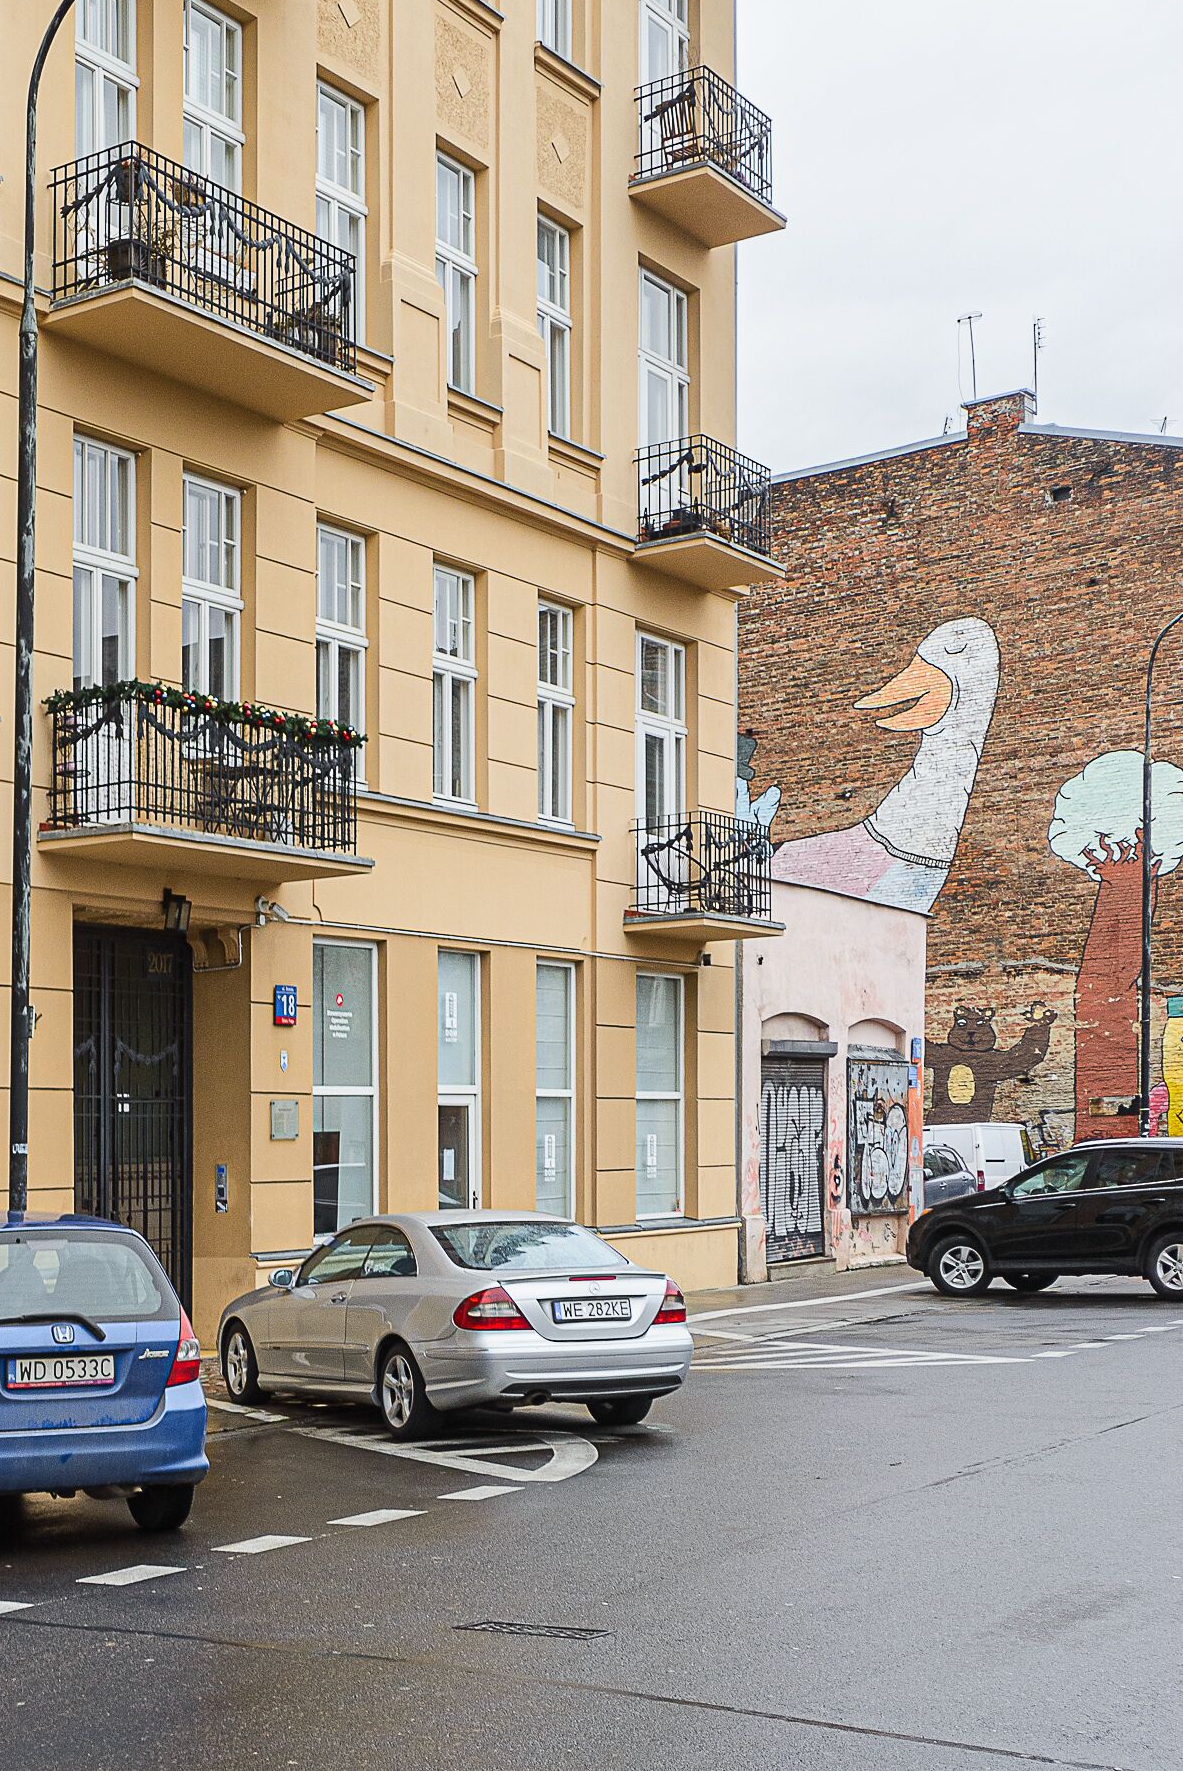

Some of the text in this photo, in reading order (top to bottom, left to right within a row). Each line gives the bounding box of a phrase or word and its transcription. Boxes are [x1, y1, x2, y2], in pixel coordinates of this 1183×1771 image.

[148, 952, 174, 974] 2017
[281, 994, 295, 1016] 18
[562, 1302, 584, 1318] WE
[587, 1300, 629, 1317] 282KE
[20, 1358, 111, 1381] WD 0533C
